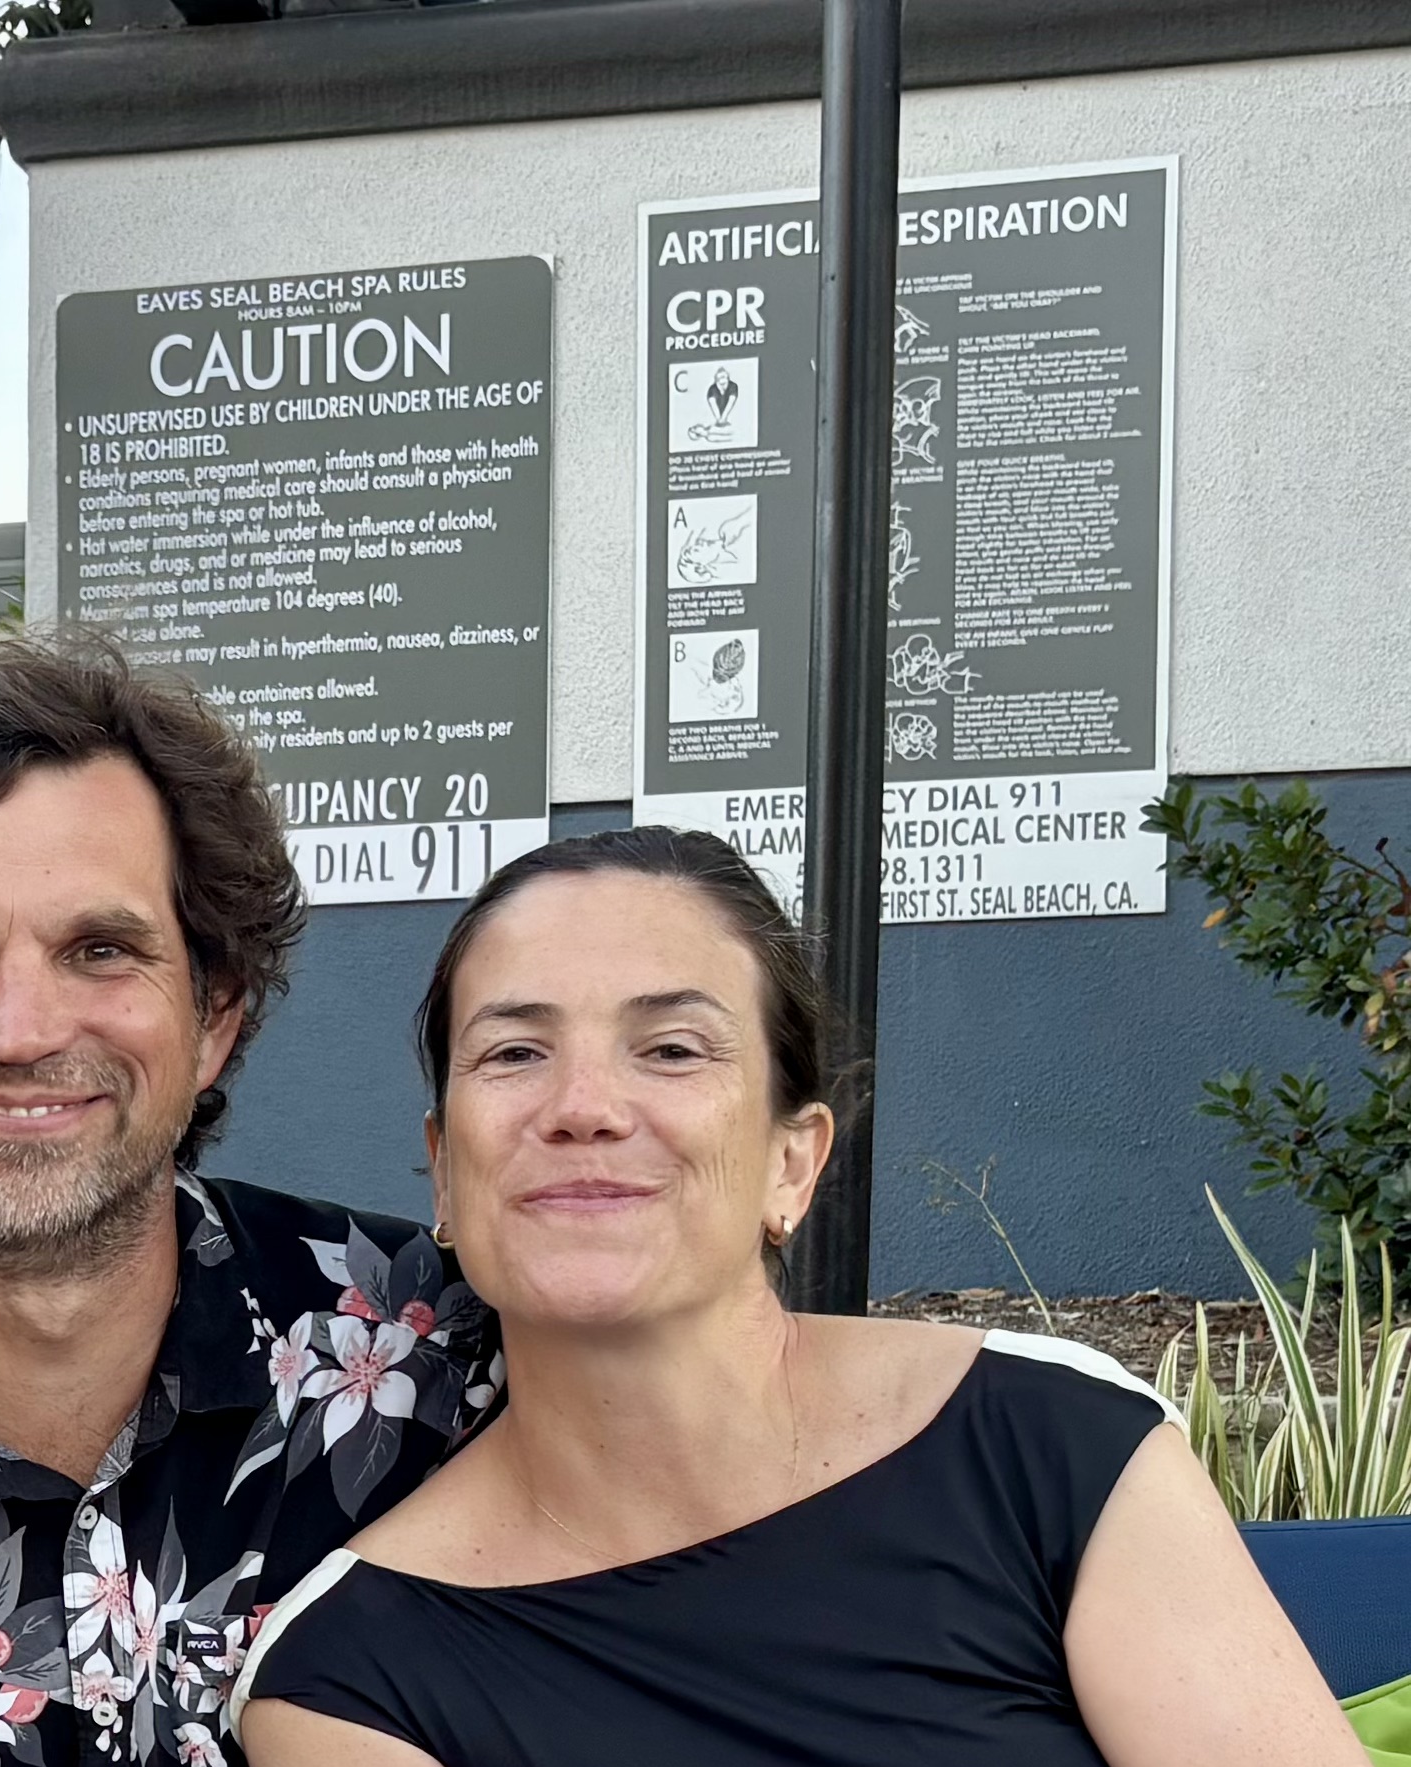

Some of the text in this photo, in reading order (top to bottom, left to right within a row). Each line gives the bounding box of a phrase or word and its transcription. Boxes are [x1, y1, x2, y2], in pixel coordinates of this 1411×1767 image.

[658, 192, 1128, 267] ARTIFICI ESPIRATION
[137, 267, 466, 314] EAVES SEAL BEACH SPA RULES
[666, 286, 766, 334] CPR
[237, 305, 283, 321] HOURS
[149, 312, 451, 397] CAUTION
[665, 329, 765, 351] PROCEDURE
[673, 370, 688, 393] C
[78, 380, 544, 438] UNSUPERVISED USE BY CHILDREN UNDER THE AGE OF
[78, 435, 539, 492] Elderly persons, pregnant women, infants and those with health
[80, 434, 230, 466] 18 IS PROHIBITED.
[79, 463, 512, 511] conditions medical care should consult physician
[79, 496, 325, 533] before entering the spa or hot tub.
[79, 507, 498, 556] Hot water immersion while under the influence of alcohol,
[673, 505, 688, 529] A
[79, 535, 463, 578] narcotics, drugs, and or medicine may lead to serious
[180, 565, 318, 593] and not allowed.
[152, 582, 404, 622] spa temperature 104 degrees (40).
[185, 624, 540, 665] may result in hyperthermia, nausea, dizziness, or
[674, 640, 686, 662] B
[238, 675, 379, 705] containers allowed.
[280, 719, 514, 748] residents and up to 2 guests per
[268, 773, 489, 824] UPANCY 20
[927, 783, 998, 812] DIAL
[1009, 780, 1061, 809] 911
[882, 816, 1006, 850] MEDICAL
[1014, 810, 1127, 845] CENTER
[315, 823, 493, 894] DIAL 911
[880, 880, 1139, 919] FIRST ST. SEAL BEACH, CA.
